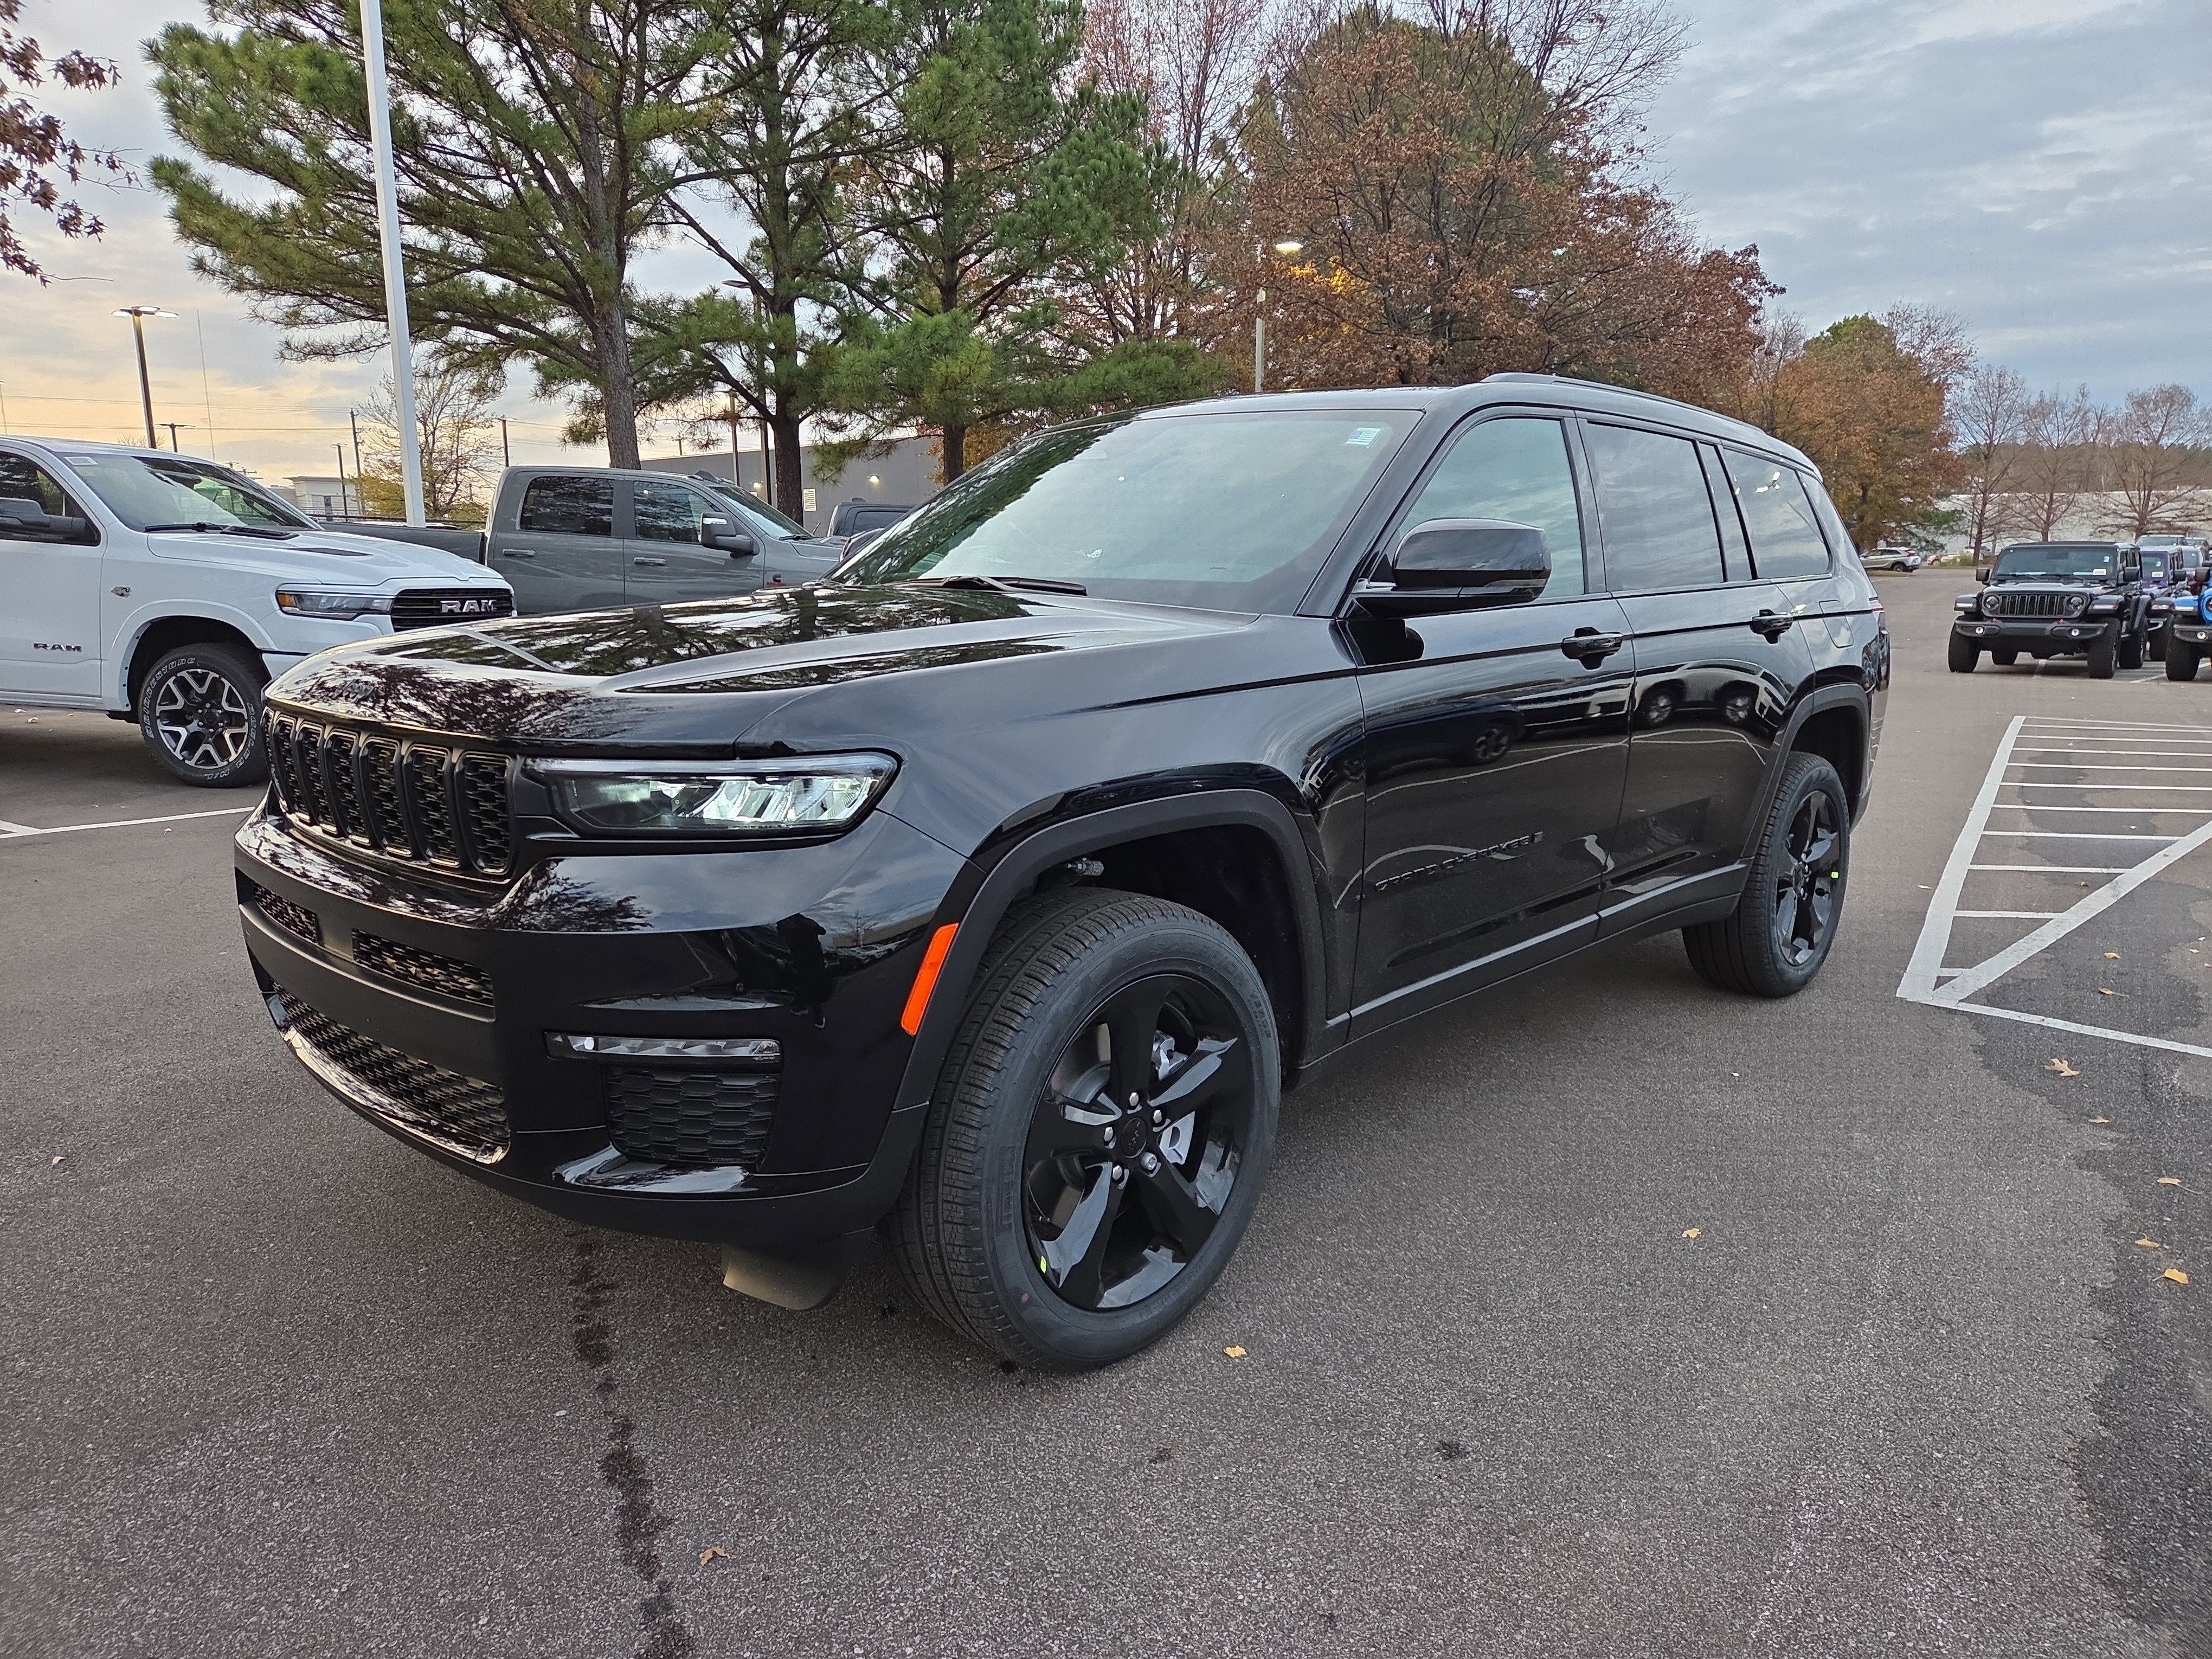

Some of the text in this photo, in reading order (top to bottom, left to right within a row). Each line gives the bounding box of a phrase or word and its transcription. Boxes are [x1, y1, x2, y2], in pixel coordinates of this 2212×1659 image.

[440, 599, 497, 613] RAM
[33, 642, 82, 653] RAM
[143, 657, 196, 739] BRIDGESTONE
